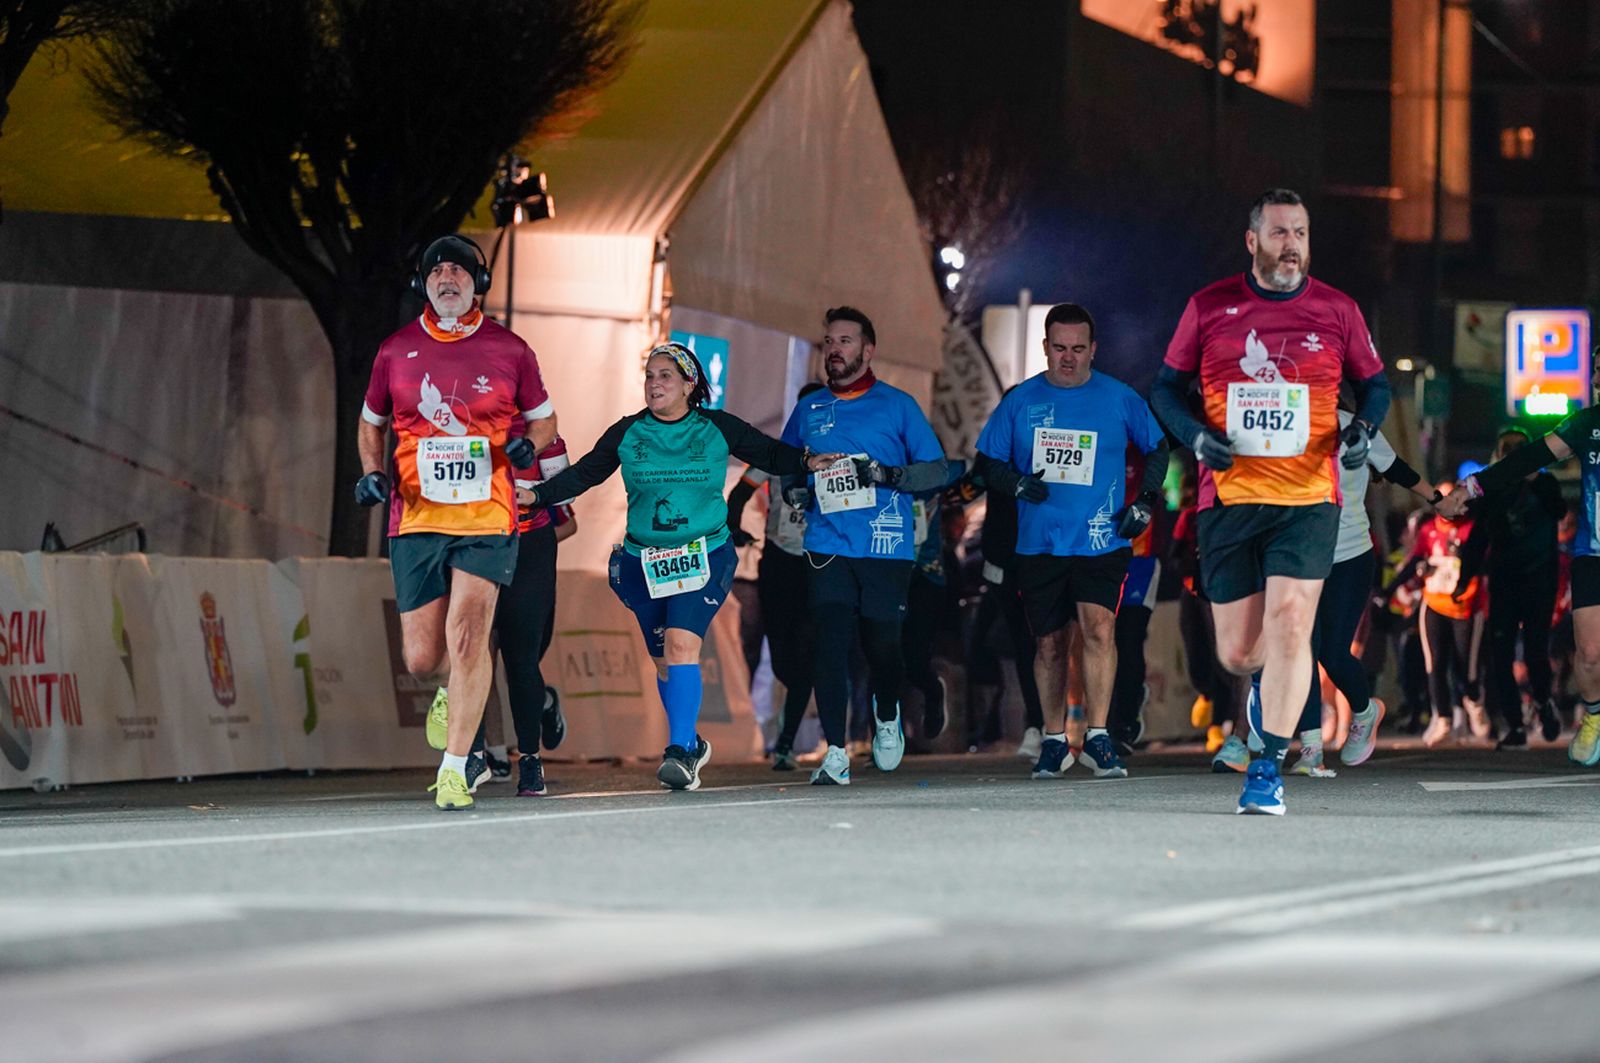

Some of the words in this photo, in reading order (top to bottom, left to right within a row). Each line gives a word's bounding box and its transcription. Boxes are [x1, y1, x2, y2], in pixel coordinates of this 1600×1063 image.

[1522, 321, 1573, 373] P
[1254, 367, 1276, 383] 43
[1247, 390, 1269, 398] NOCHE
[1271, 390, 1280, 398] DE
[1237, 400, 1252, 408] SAN
[433, 408, 450, 427] 43
[1243, 409, 1294, 431] 6452
[426, 452, 440, 460] SAN
[435, 444, 455, 452] NOCHE
[1045, 448, 1083, 466] 5729
[434, 460, 476, 481] 5179
[644, 469, 678, 477] CARRERA
[679, 468, 711, 476] POPULAR
[648, 554, 661, 562] SAN
[651, 554, 700, 578] 13464
[0, 610, 46, 666] SAN
